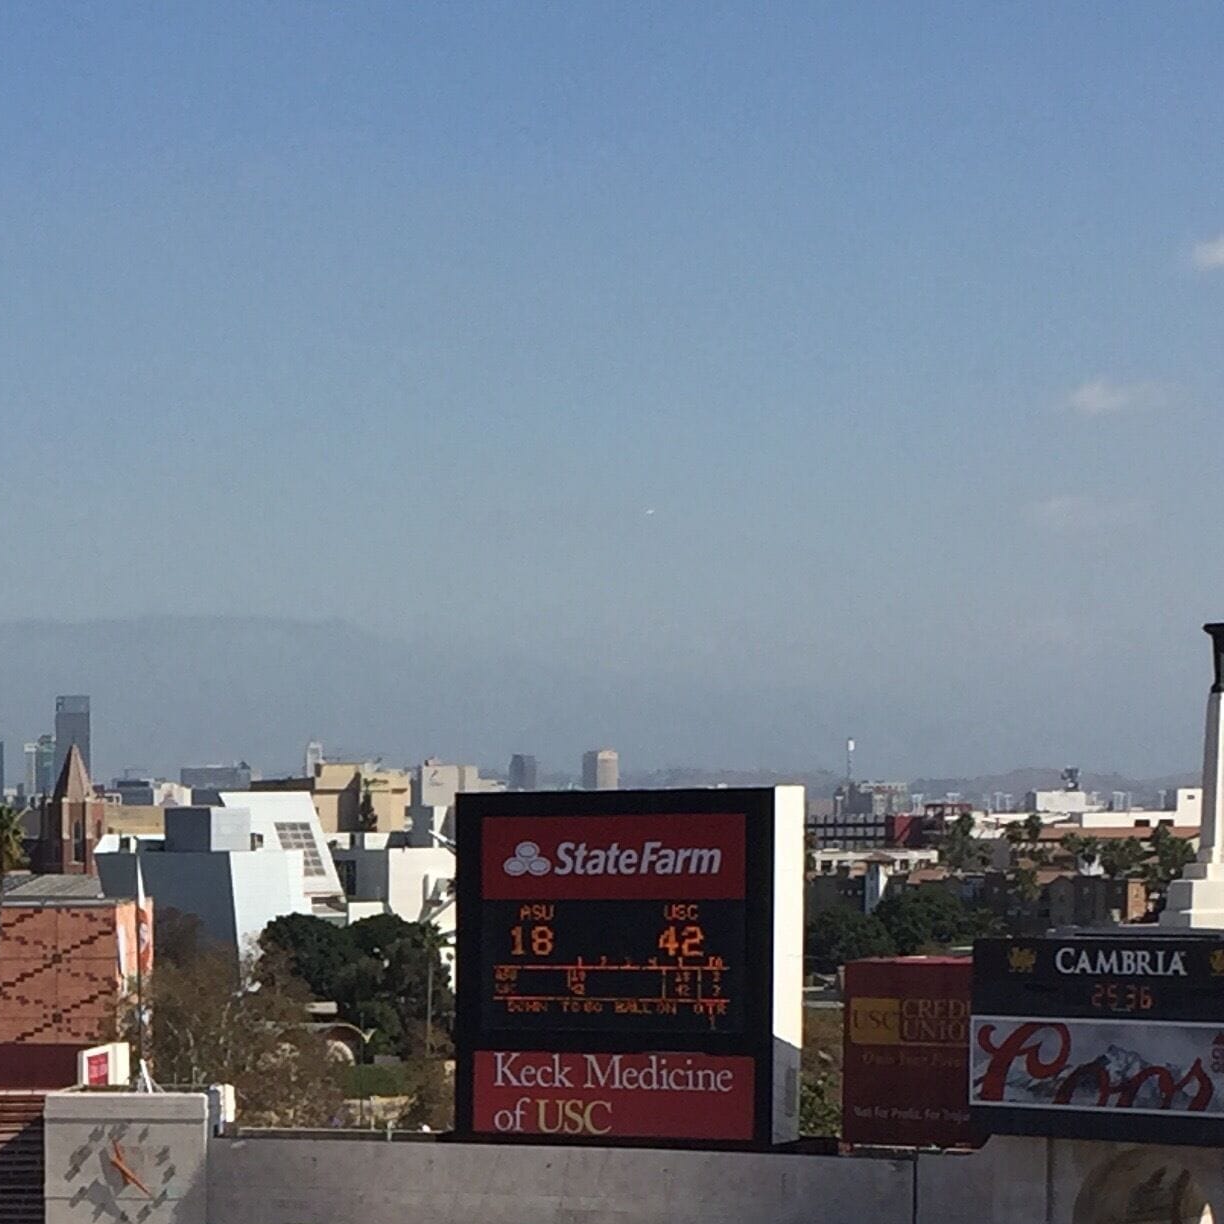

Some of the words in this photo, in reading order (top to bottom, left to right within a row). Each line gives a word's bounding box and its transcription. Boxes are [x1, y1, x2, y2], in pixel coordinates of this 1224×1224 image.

[520, 904, 555, 920] ASU
[510, 925, 554, 956] 18
[658, 925, 705, 957] 42
[1054, 947, 1189, 977] CAMBRIA
[902, 999, 971, 1019] CREDI
[903, 1020, 966, 1040] UNIO
[492, 1051, 574, 1088] Keck
[583, 1054, 733, 1092] Medicine
[493, 1097, 531, 1133] of
[537, 1099, 613, 1135] USC
